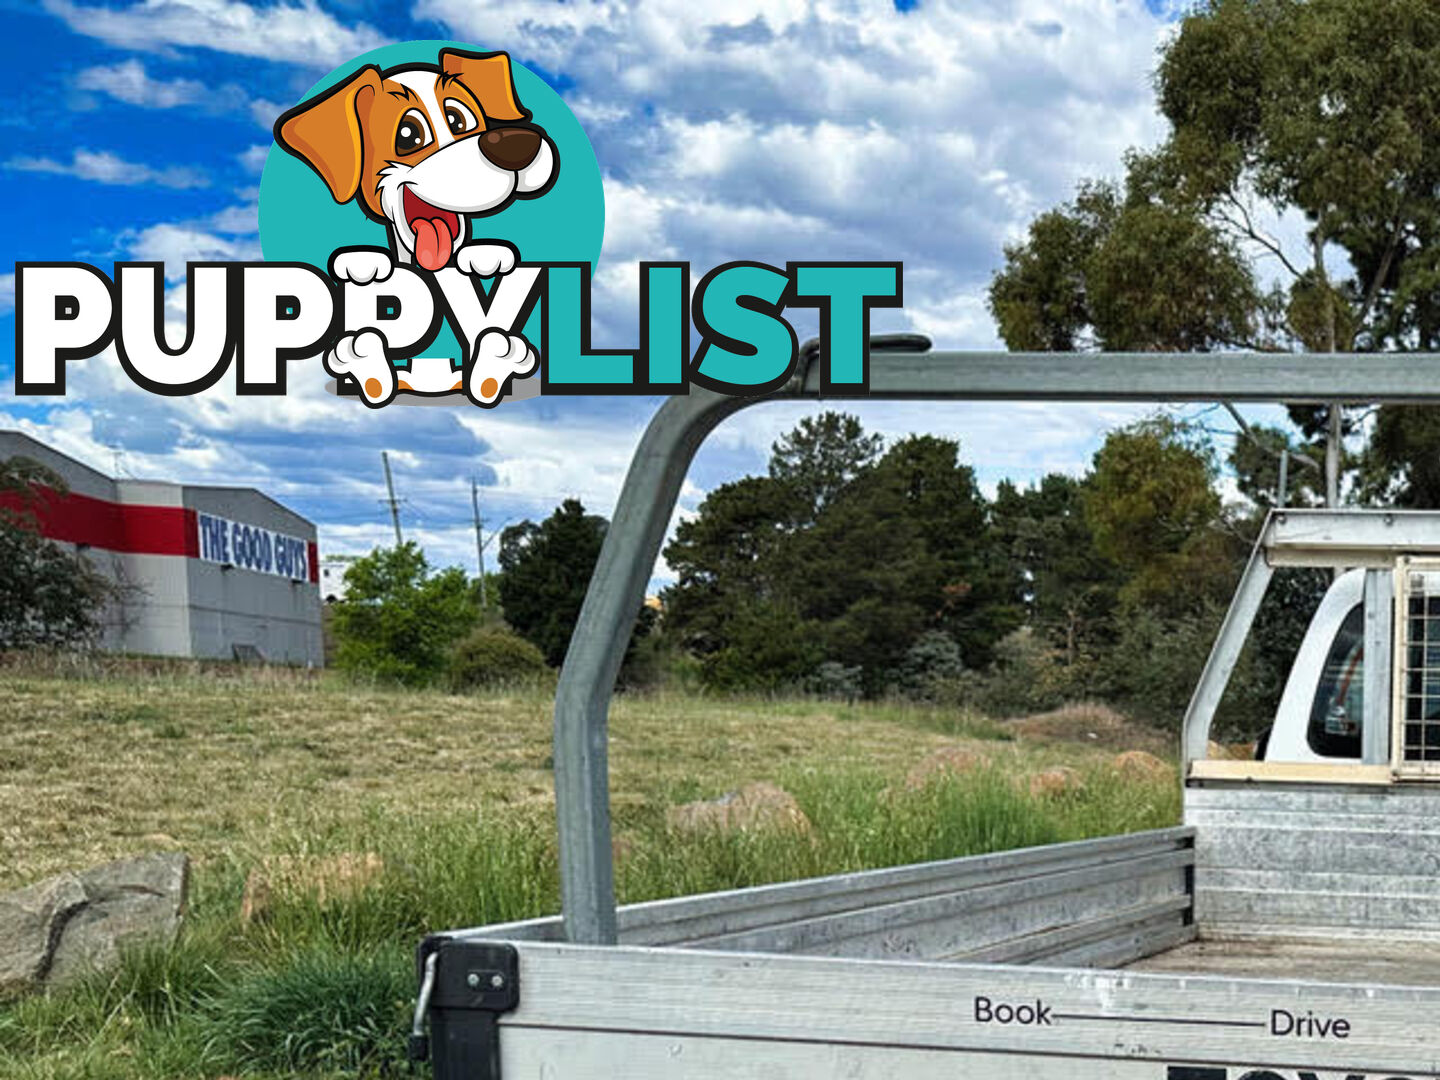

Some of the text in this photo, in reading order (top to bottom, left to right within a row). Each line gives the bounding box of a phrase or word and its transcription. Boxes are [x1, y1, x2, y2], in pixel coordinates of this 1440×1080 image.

[200, 515, 306, 580] THE GOOD GUYS
[974, 999, 1350, 1039] Book Drive
